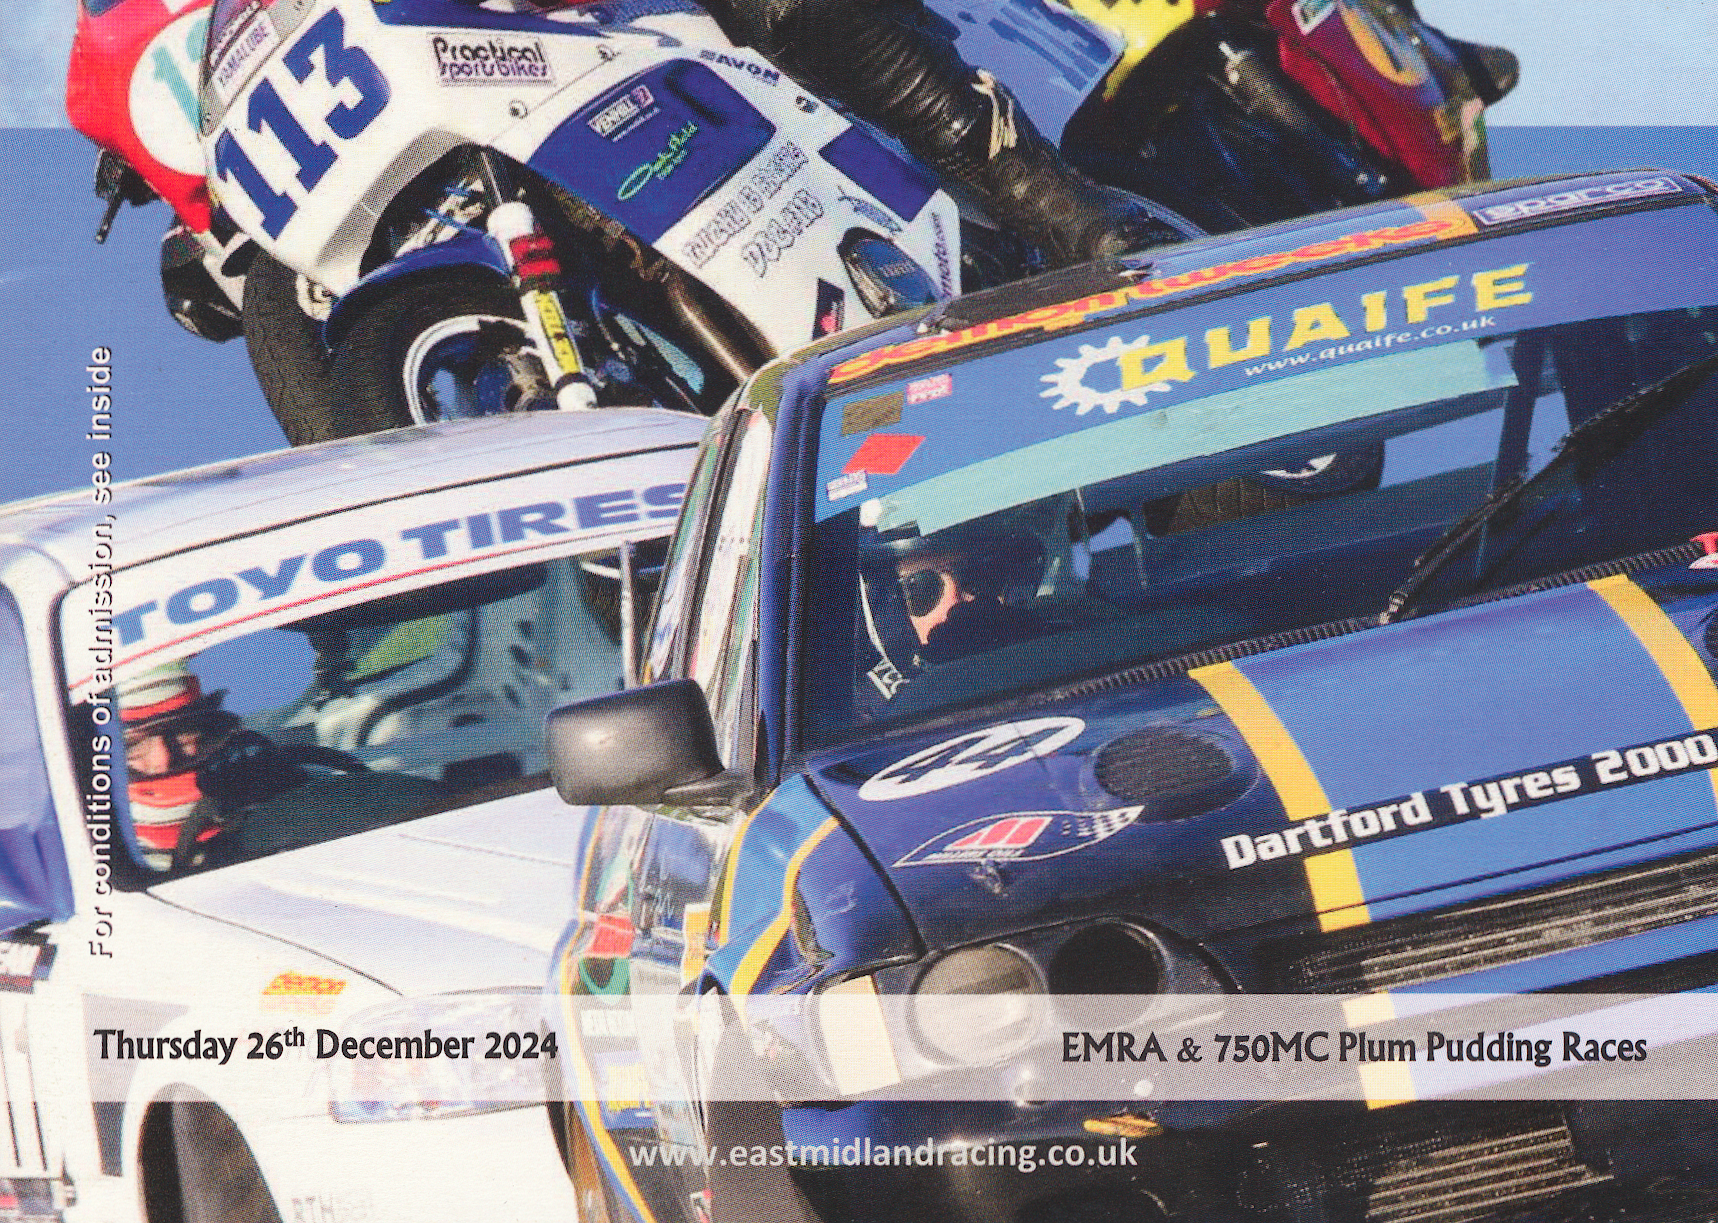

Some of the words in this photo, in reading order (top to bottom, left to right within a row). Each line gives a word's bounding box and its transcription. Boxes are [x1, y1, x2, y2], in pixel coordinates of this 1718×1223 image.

[432, 36, 546, 63] Practical
[715, 53, 781, 82] AVON
[215, 8, 391, 240] 113
[1485, 179, 1665, 219] sparco
[1118, 263, 1534, 392] QUAIFE
[1244, 314, 1497, 379] www.quaife.co.uk
[110, 541, 386, 647] TOYO
[402, 481, 690, 558] TIRES
[1222, 791, 1434, 870] Dartford
[1440, 762, 1583, 820] Tyres
[1597, 732, 1718, 781] 2000
